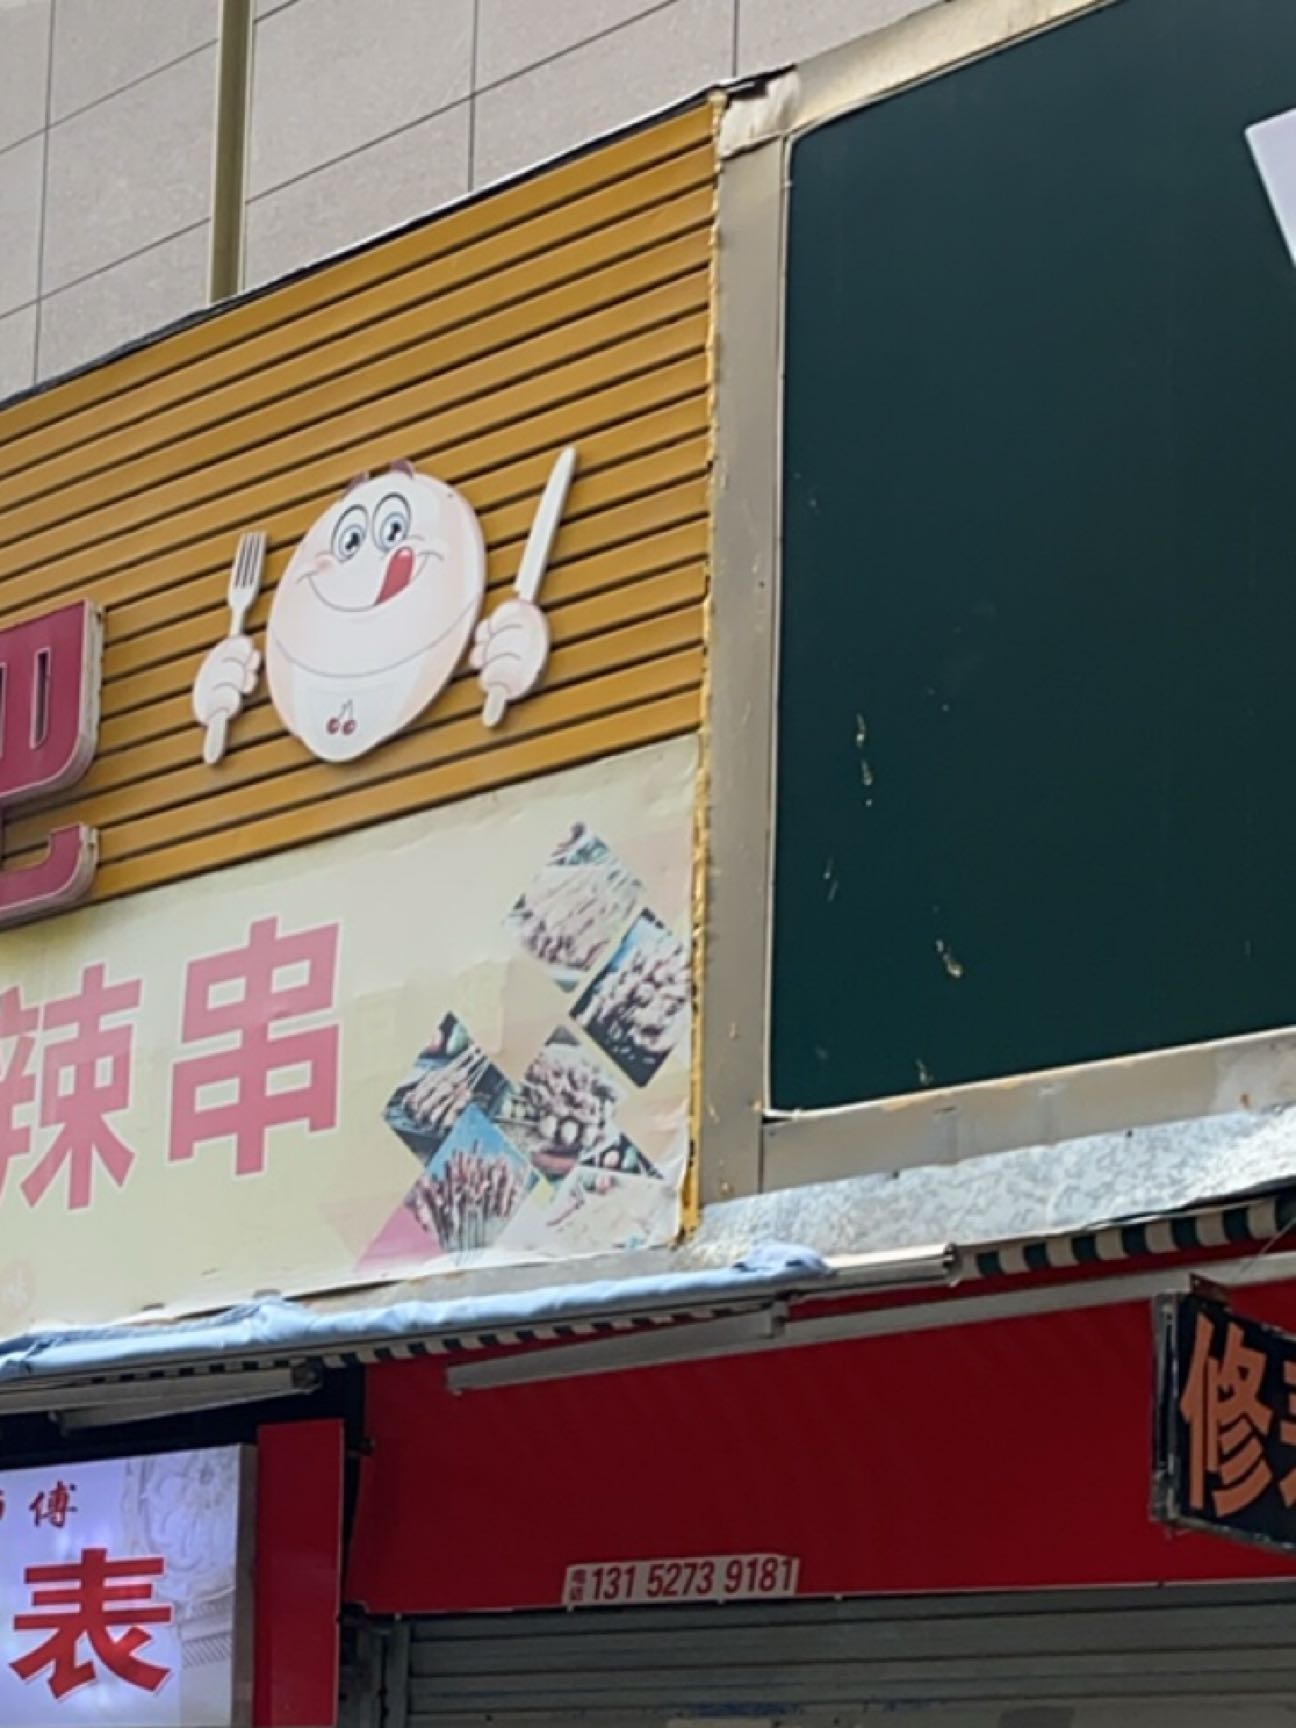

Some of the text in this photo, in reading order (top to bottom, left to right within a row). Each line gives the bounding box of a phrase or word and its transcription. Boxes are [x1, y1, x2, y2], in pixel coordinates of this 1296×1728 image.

[1180, 1312, 1296, 1518] 修
[592, 1565, 636, 1600] 131
[647, 1562, 714, 1598] 5273
[724, 1557, 793, 1594] 9181
